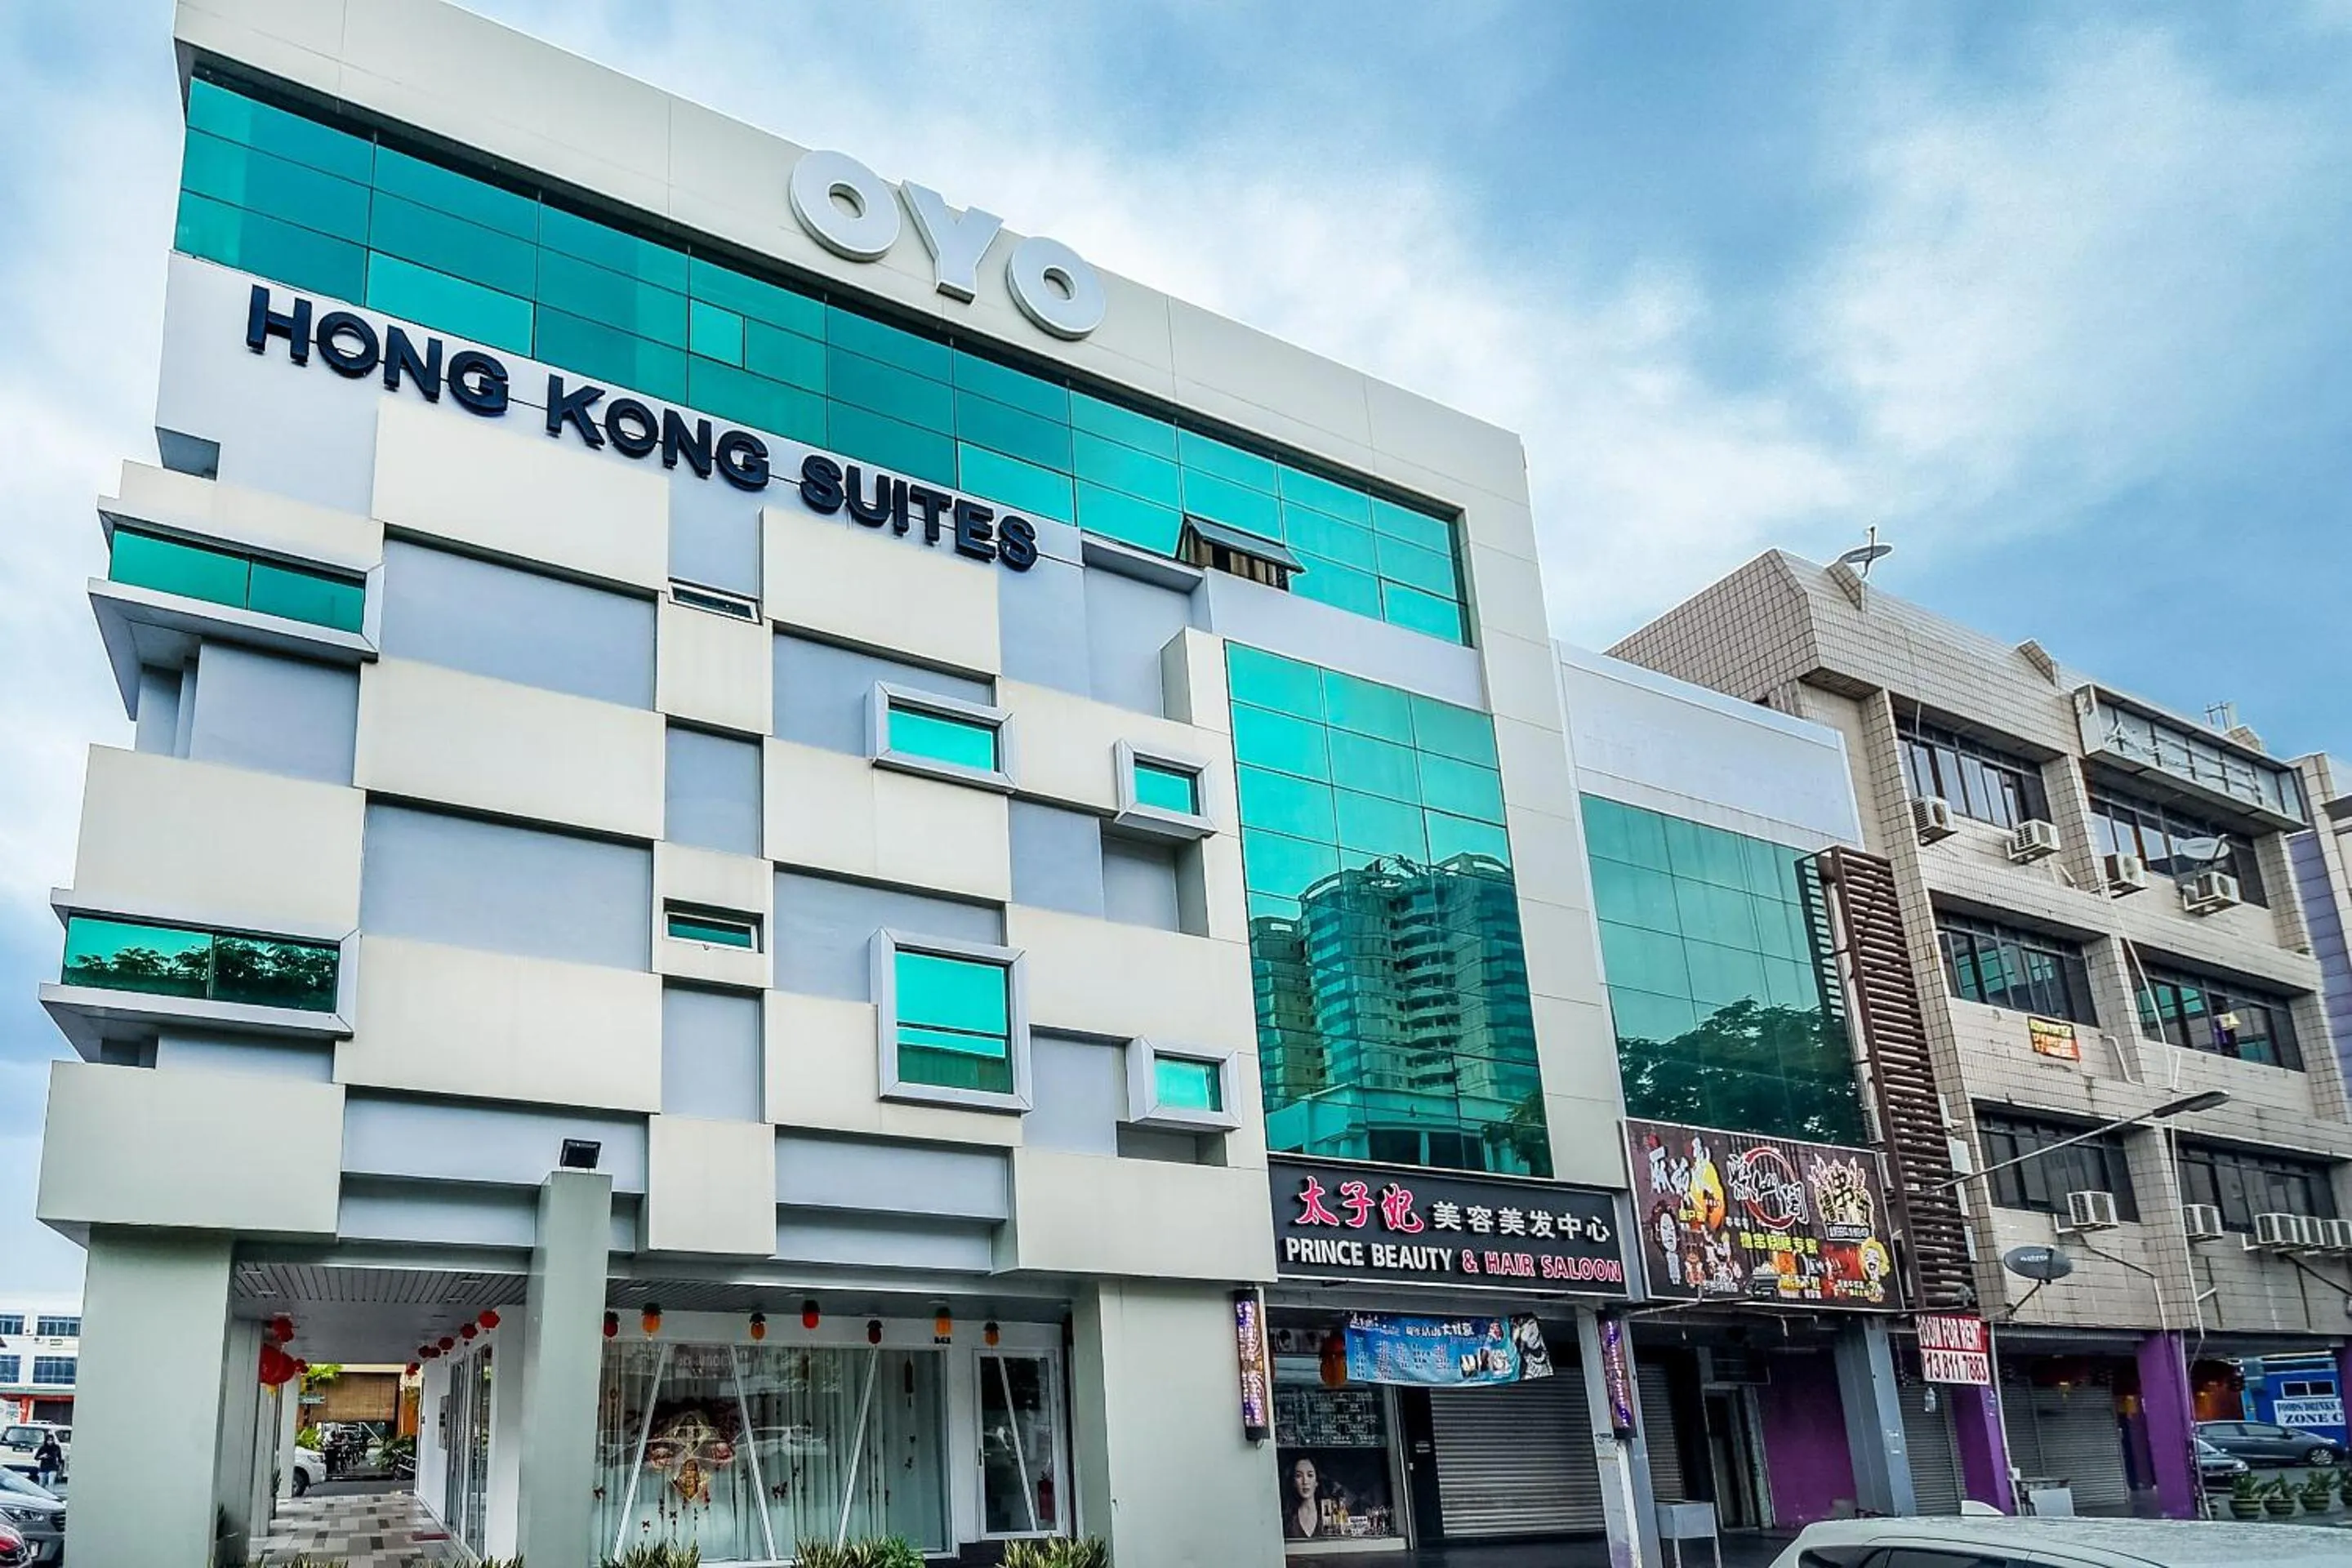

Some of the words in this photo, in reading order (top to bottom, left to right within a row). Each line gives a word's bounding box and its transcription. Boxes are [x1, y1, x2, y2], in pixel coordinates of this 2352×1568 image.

[789, 150, 1106, 341] OYO
[246, 284, 509, 416] HONG
[546, 374, 769, 490] KONG
[800, 454, 1038, 572] SUITES
[1295, 1175, 1424, 1234] 太子妃
[1432, 1200, 1610, 1244] 美容美发中心
[1285, 1236, 1365, 1267] PRINCE
[1371, 1243, 1453, 1272] BEAUTY
[1462, 1249, 1480, 1273] &
[1485, 1250, 1536, 1277] HAIR
[1541, 1255, 1623, 1283] SALOON
[1940, 1316, 1961, 1349] FOR
[1958, 1318, 1983, 1352] RENT
[2285, 1414, 2329, 1424] ZONE
